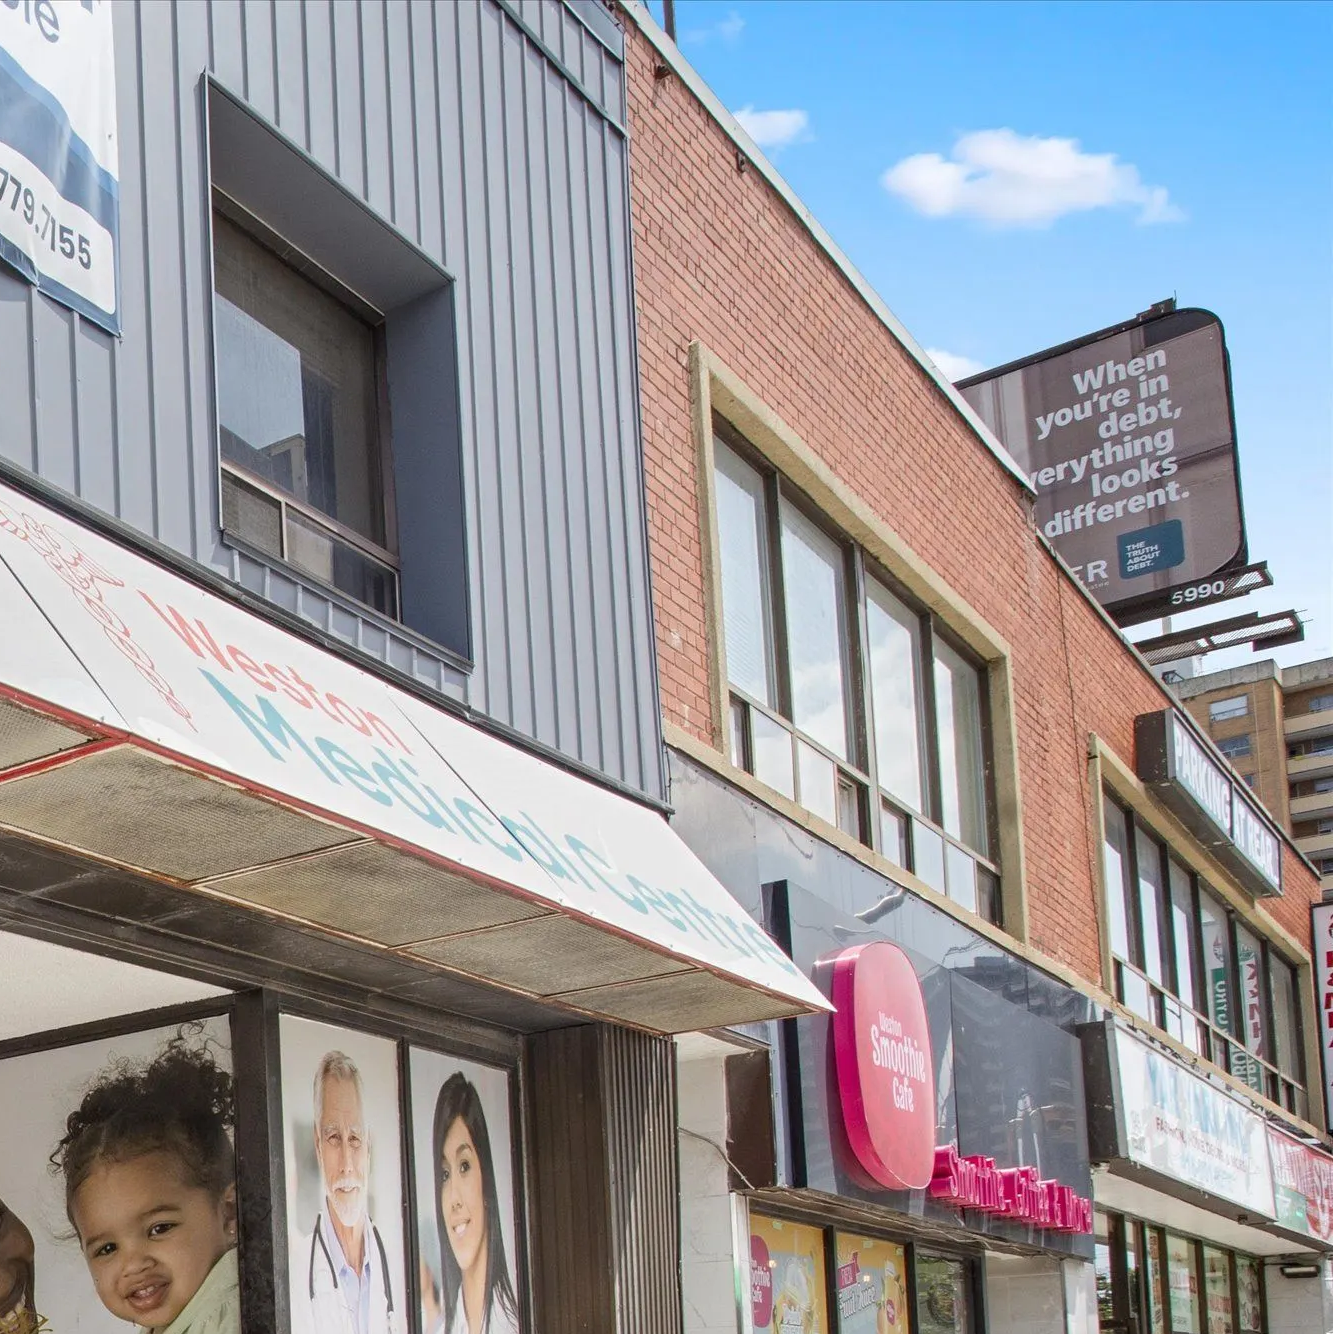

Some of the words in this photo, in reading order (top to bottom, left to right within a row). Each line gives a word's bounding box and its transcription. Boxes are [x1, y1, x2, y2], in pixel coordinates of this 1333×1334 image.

[1073, 348, 1166, 395] When
[1035, 385, 1129, 440] you're
[1139, 370, 1168, 400] in
[1098, 395, 1182, 439] debt,
[1029, 427, 1175, 494] verything
[1091, 456, 1178, 498] looks
[1044, 489, 1190, 538] different.
[1126, 541, 1146, 551] THE
[1126, 544, 1158, 558] TRUTH
[1126, 551, 1161, 566] ABOUT
[1127, 560, 1154, 572] DEBT.
[1171, 580, 1225, 605] 5990
[137, 588, 414, 754] Weston
[1174, 722, 1231, 830] PARKING
[1234, 797, 1245, 848] AT
[199, 668, 573, 884] Medical
[564, 832, 799, 975] Centre
[878, 1010, 902, 1038] Weston
[871, 1024, 926, 1083] Smoothie
[892, 1076, 914, 1113] Cafe
